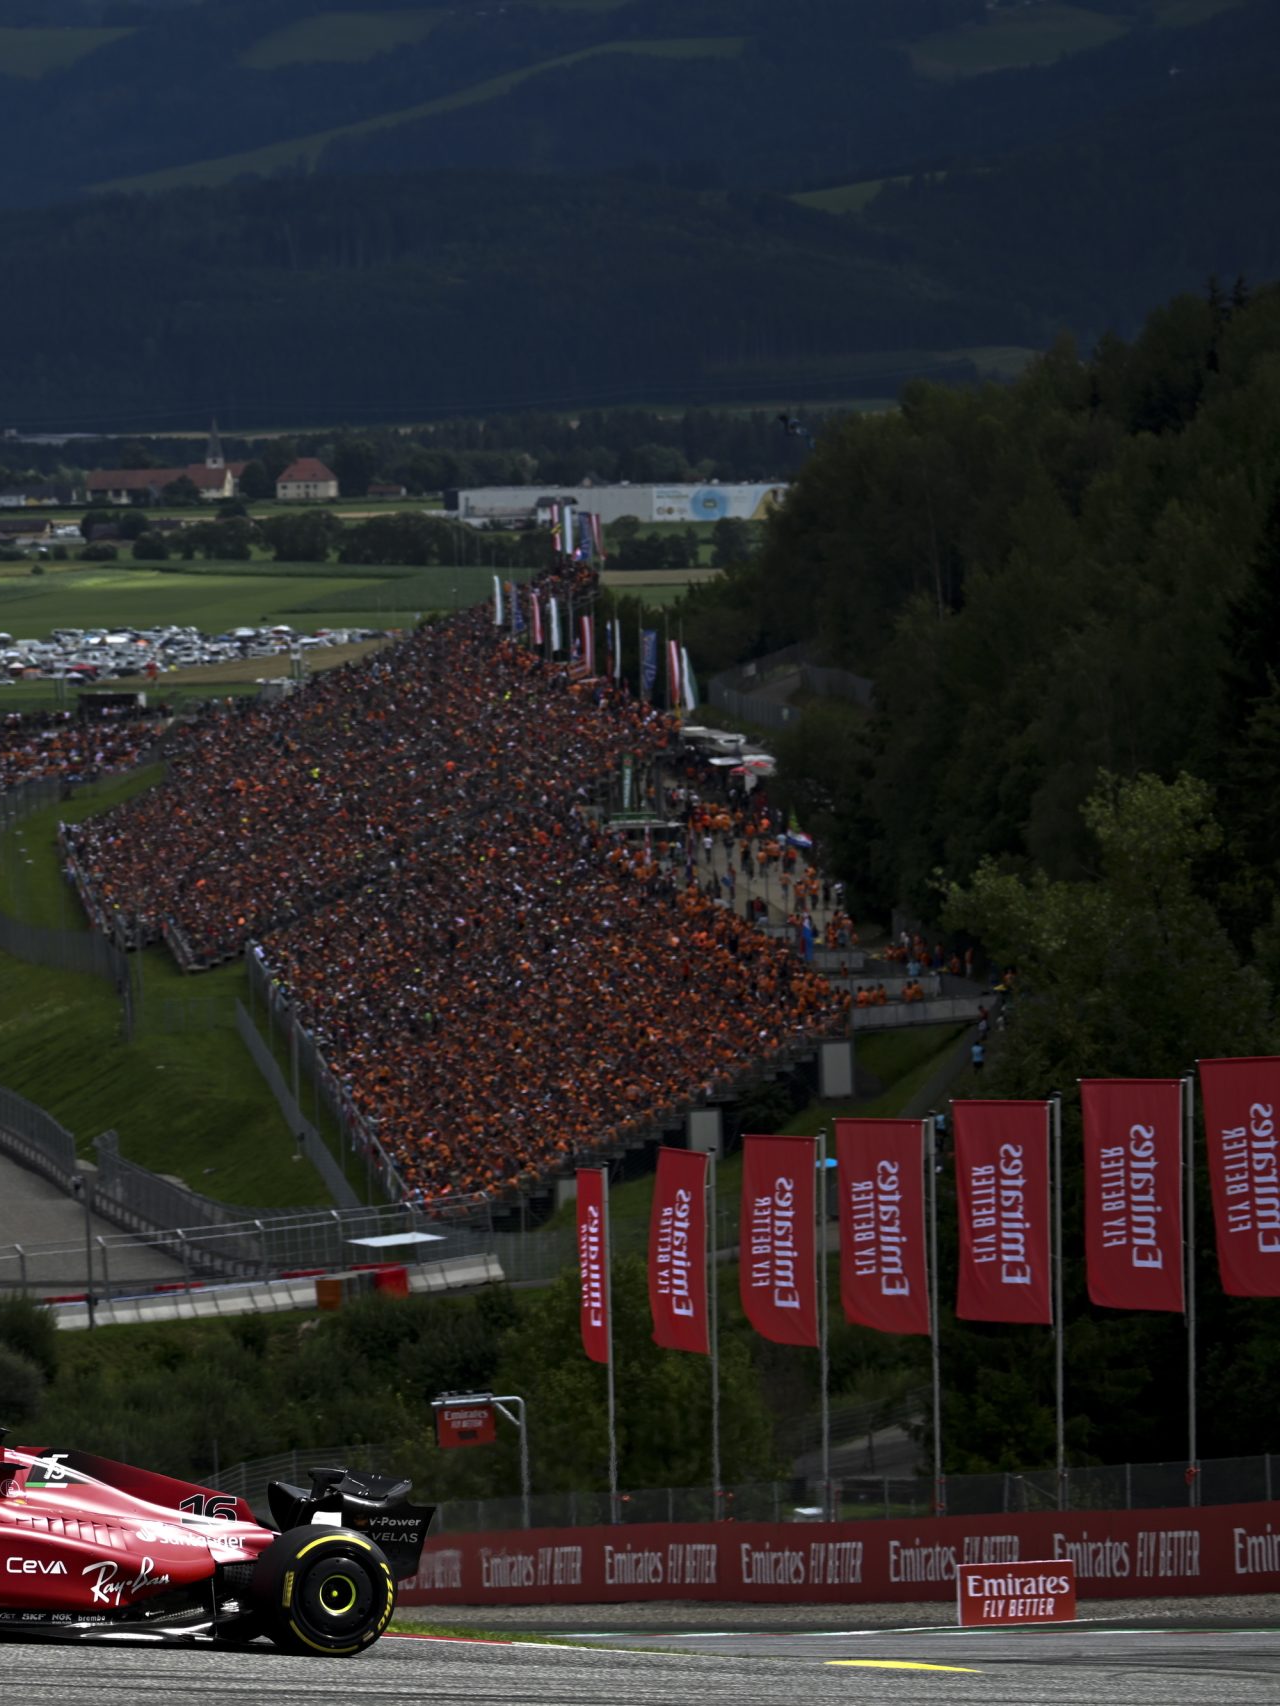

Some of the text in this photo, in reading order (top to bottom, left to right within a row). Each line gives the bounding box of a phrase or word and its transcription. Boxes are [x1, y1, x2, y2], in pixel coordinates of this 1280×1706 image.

[180, 1493, 238, 1525] 16
[604, 1544, 662, 1584] Emirates
[685, 1544, 717, 1583] BETTER
[740, 1541, 863, 1584] Emirates FLY BETTER
[889, 1537, 956, 1582] Emirates
[1136, 1532, 1156, 1576] FLY
[1158, 1530, 1200, 1576] BETTER
[967, 1573, 1070, 1598] Emirates
[51, 1613, 73, 1621] NGK
[983, 1597, 1055, 1618] FLY BETTER
